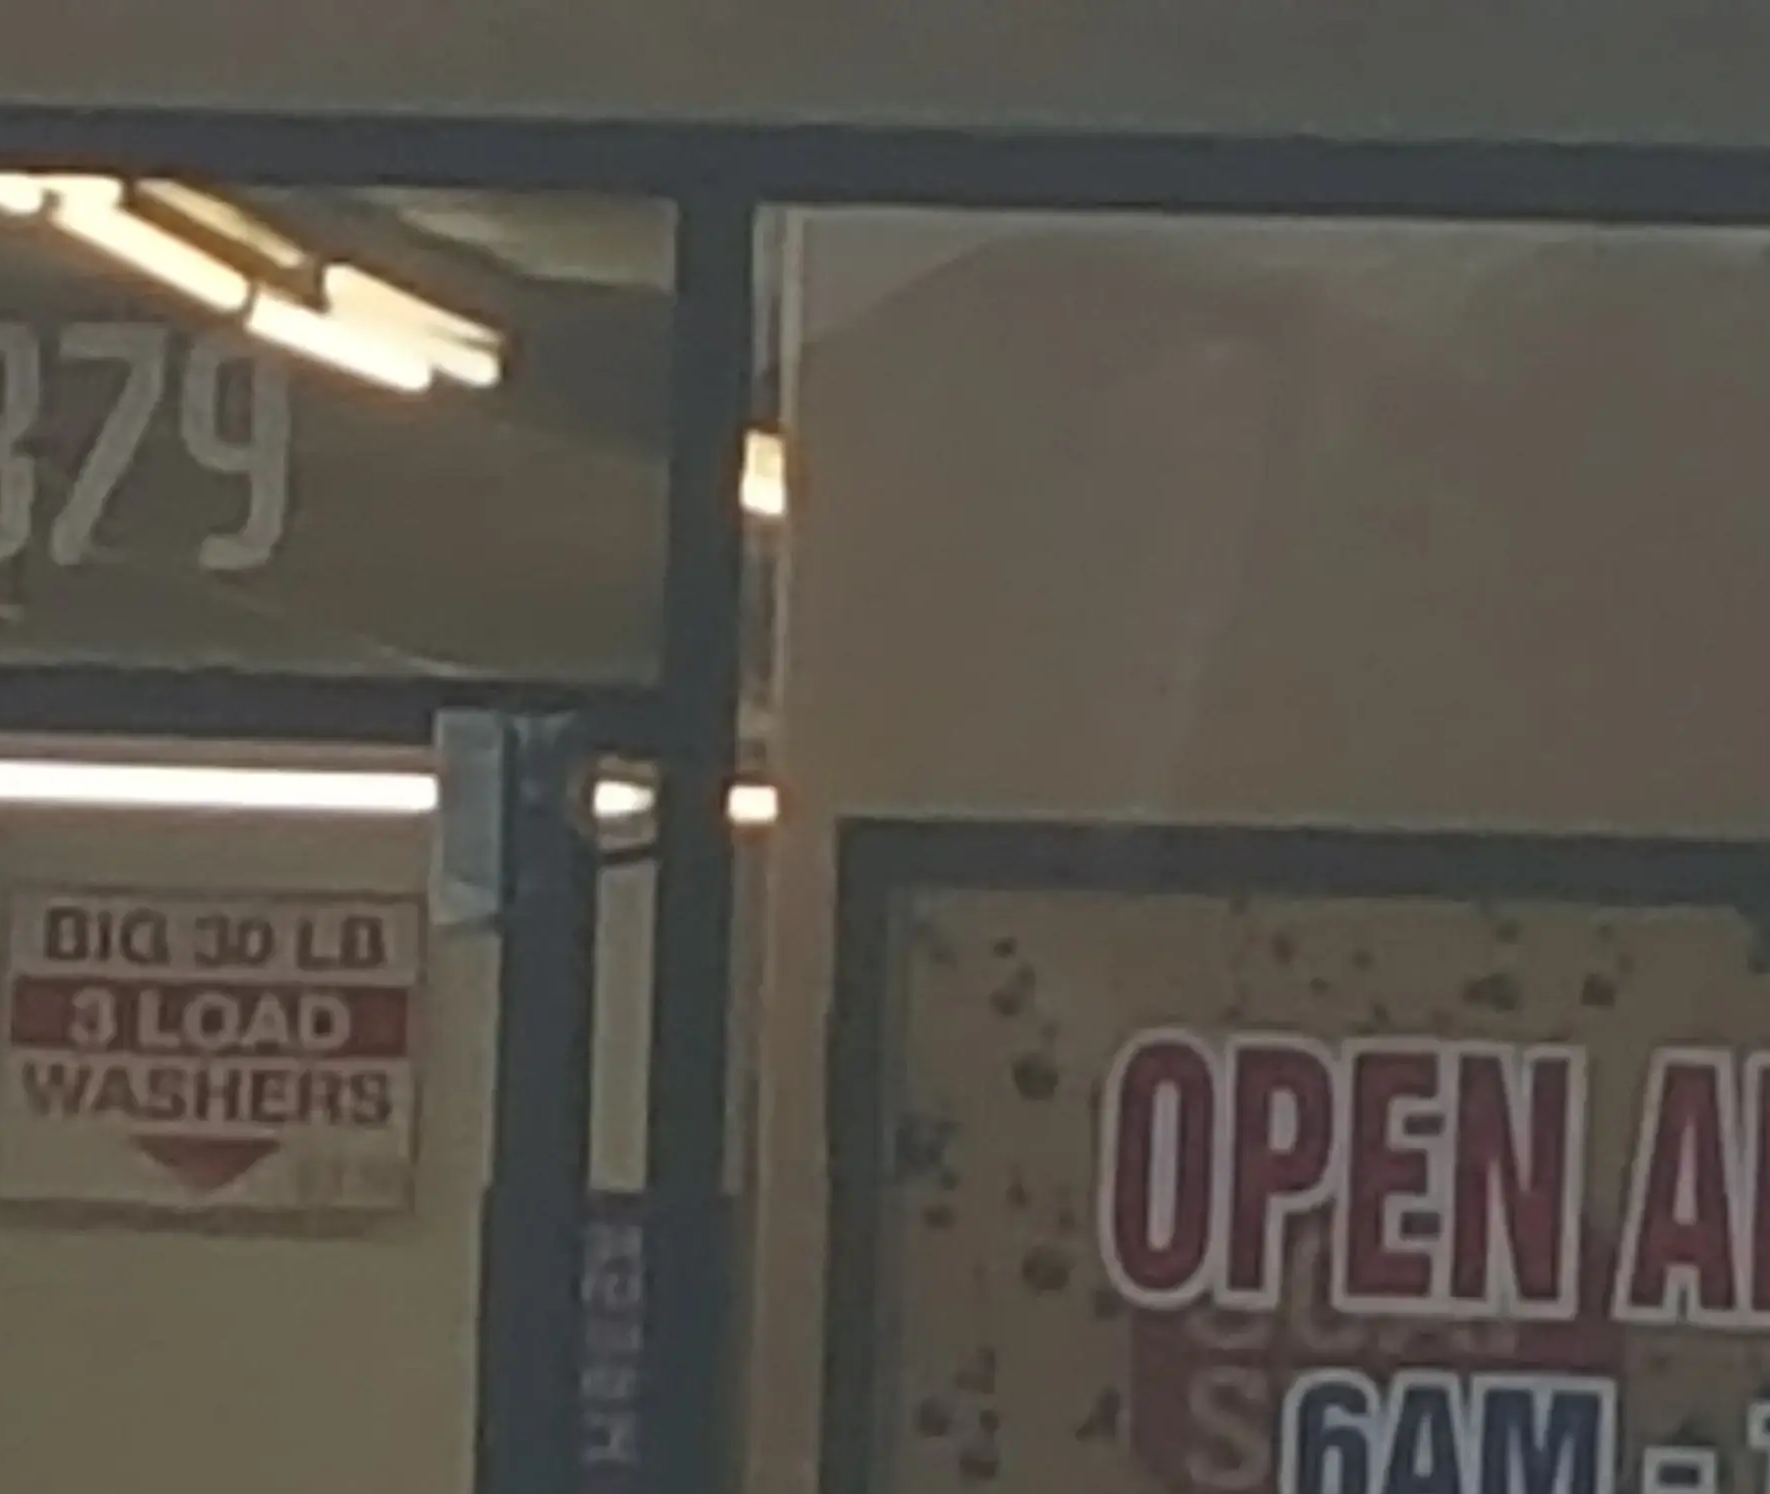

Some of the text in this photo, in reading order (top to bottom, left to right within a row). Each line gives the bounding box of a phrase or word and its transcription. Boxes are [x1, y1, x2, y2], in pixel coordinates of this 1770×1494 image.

[43, 905, 389, 972] BIG 30 LB
[69, 987, 353, 1051] 3 LOAD
[21, 1061, 394, 1127] WASHERS
[1098, 1027, 1585, 1322] OPEN
